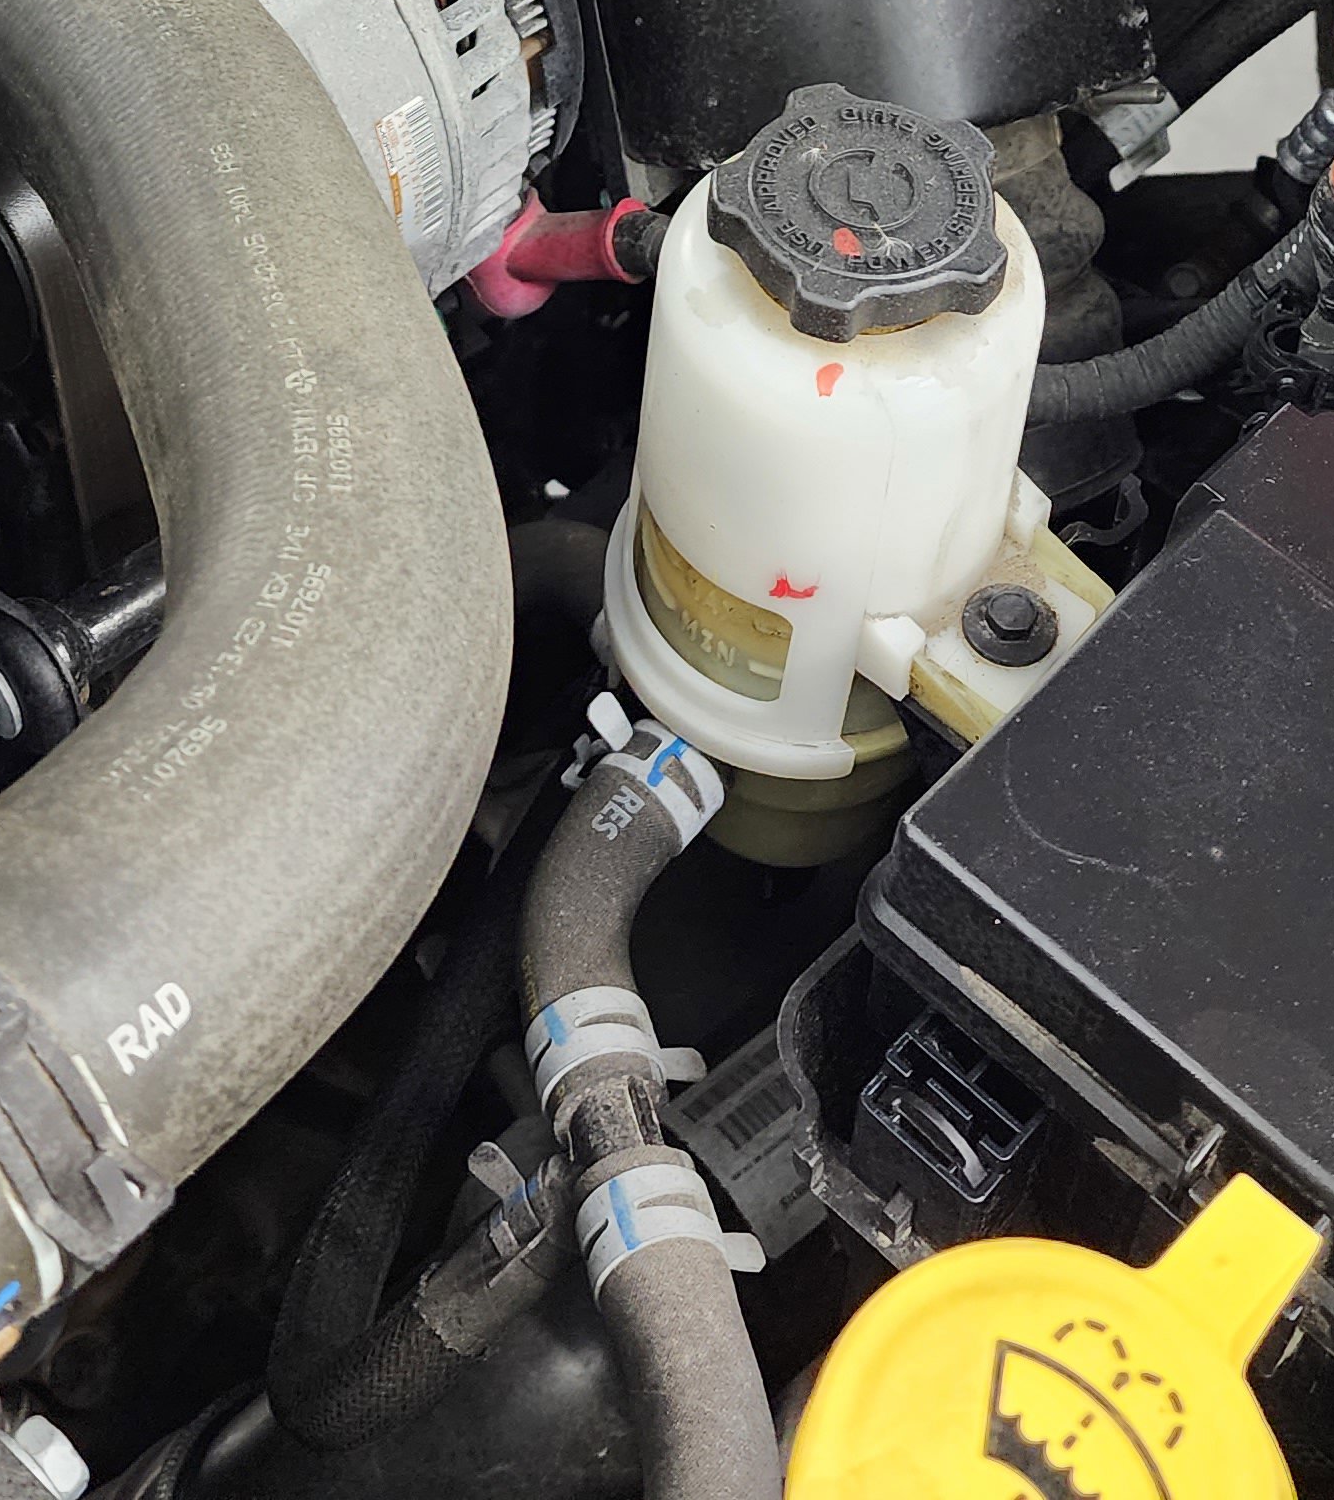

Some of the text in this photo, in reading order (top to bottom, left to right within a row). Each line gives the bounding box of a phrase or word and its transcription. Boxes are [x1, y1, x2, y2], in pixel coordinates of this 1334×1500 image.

[756, 114, 826, 260] USE APPROVED
[839, 105, 979, 271] POWER STEERING FLUID
[326, 413, 354, 493] 1107695
[269, 562, 332, 649] 1107695
[590, 785, 647, 842] RES
[106, 981, 192, 1077] RAD
